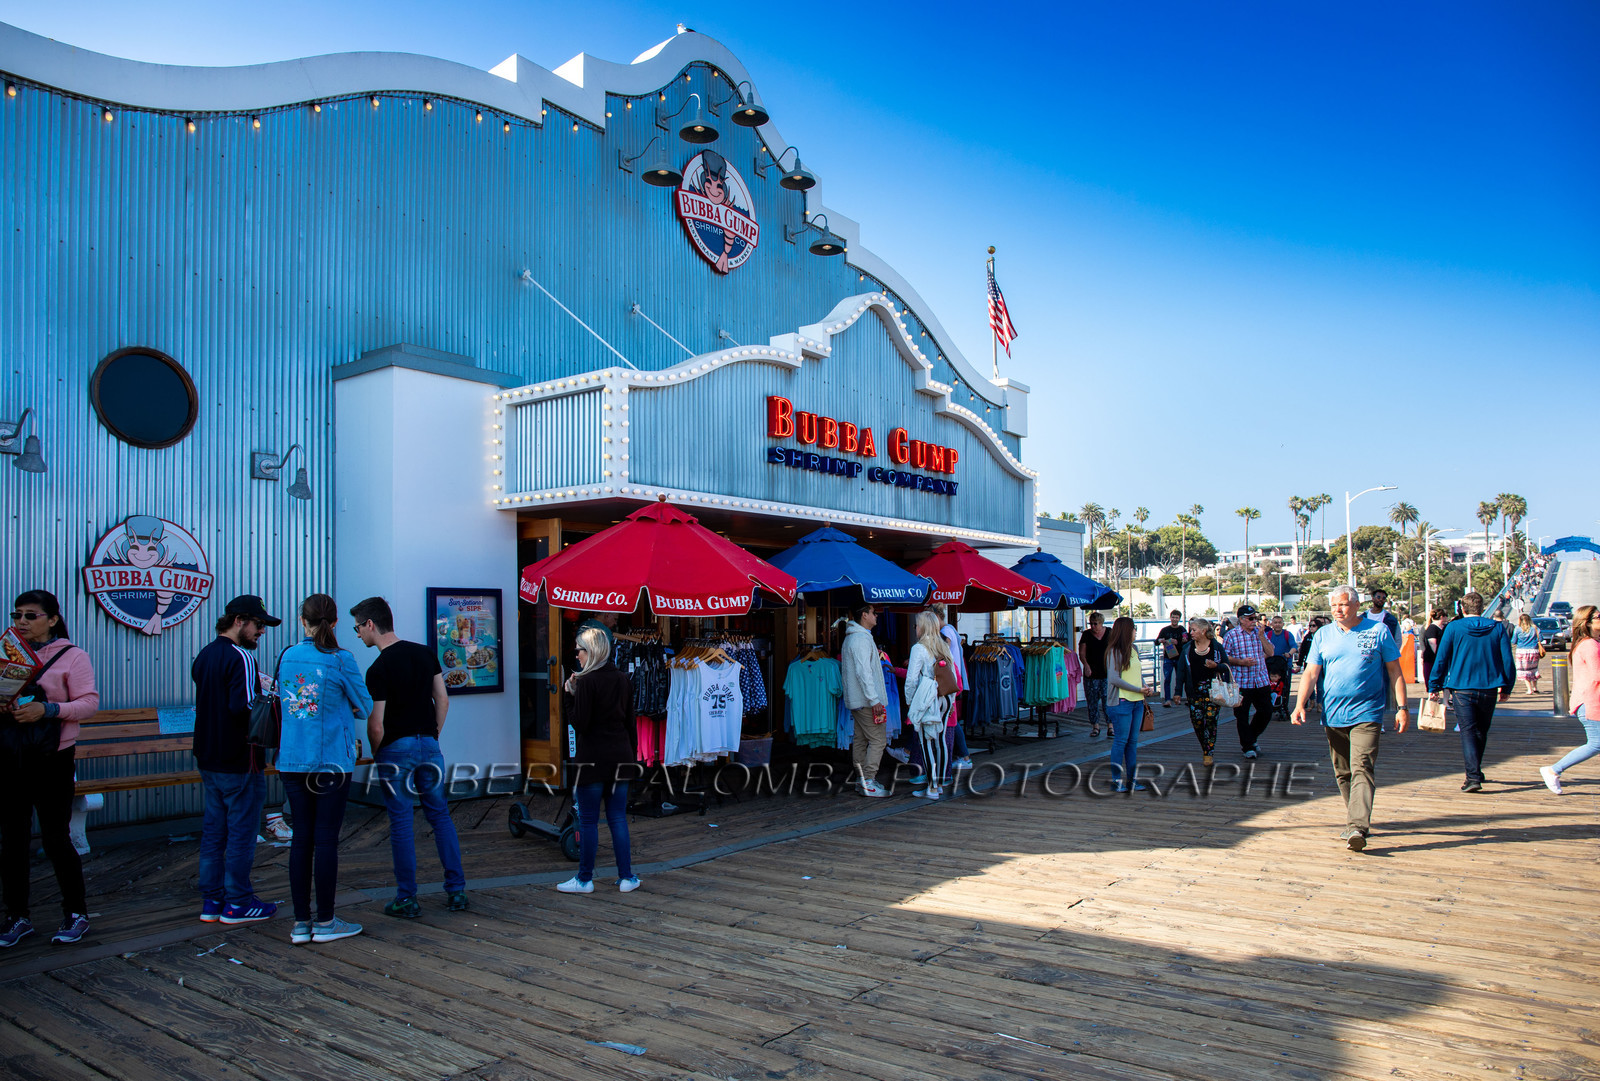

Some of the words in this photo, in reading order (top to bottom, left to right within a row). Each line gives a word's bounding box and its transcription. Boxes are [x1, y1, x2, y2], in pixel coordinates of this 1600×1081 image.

[681, 193, 722, 225] BUBBA
[724, 208, 757, 241] GUMP
[695, 221, 724, 236] SHRIMP
[687, 219, 717, 261] RESTAURANT
[734, 245, 752, 264] MARKET
[767, 395, 877, 457] BUBBA
[888, 426, 959, 474] GUMP
[768, 446, 863, 478] SHRIMP
[868, 466, 959, 496] COMPANY
[91, 568, 154, 589] BUBBA
[160, 568, 210, 594] GUMP
[111, 591, 156, 600] SHRIMP
[174, 594, 190, 603] CO
[552, 586, 604, 605] SHRIMP
[606, 592, 628, 606] CO.
[655, 594, 703, 610] BUBBA
[707, 595, 750, 610] GUMP
[870, 587, 906, 599] SHRIMP
[907, 587, 925, 599] CO.
[932, 590, 962, 601] GUMP
[1038, 596, 1054, 605] CO.
[98, 593, 144, 627] RESTAURANT
[172, 599, 200, 623] MARKET
[711, 694, 726, 710] 75
